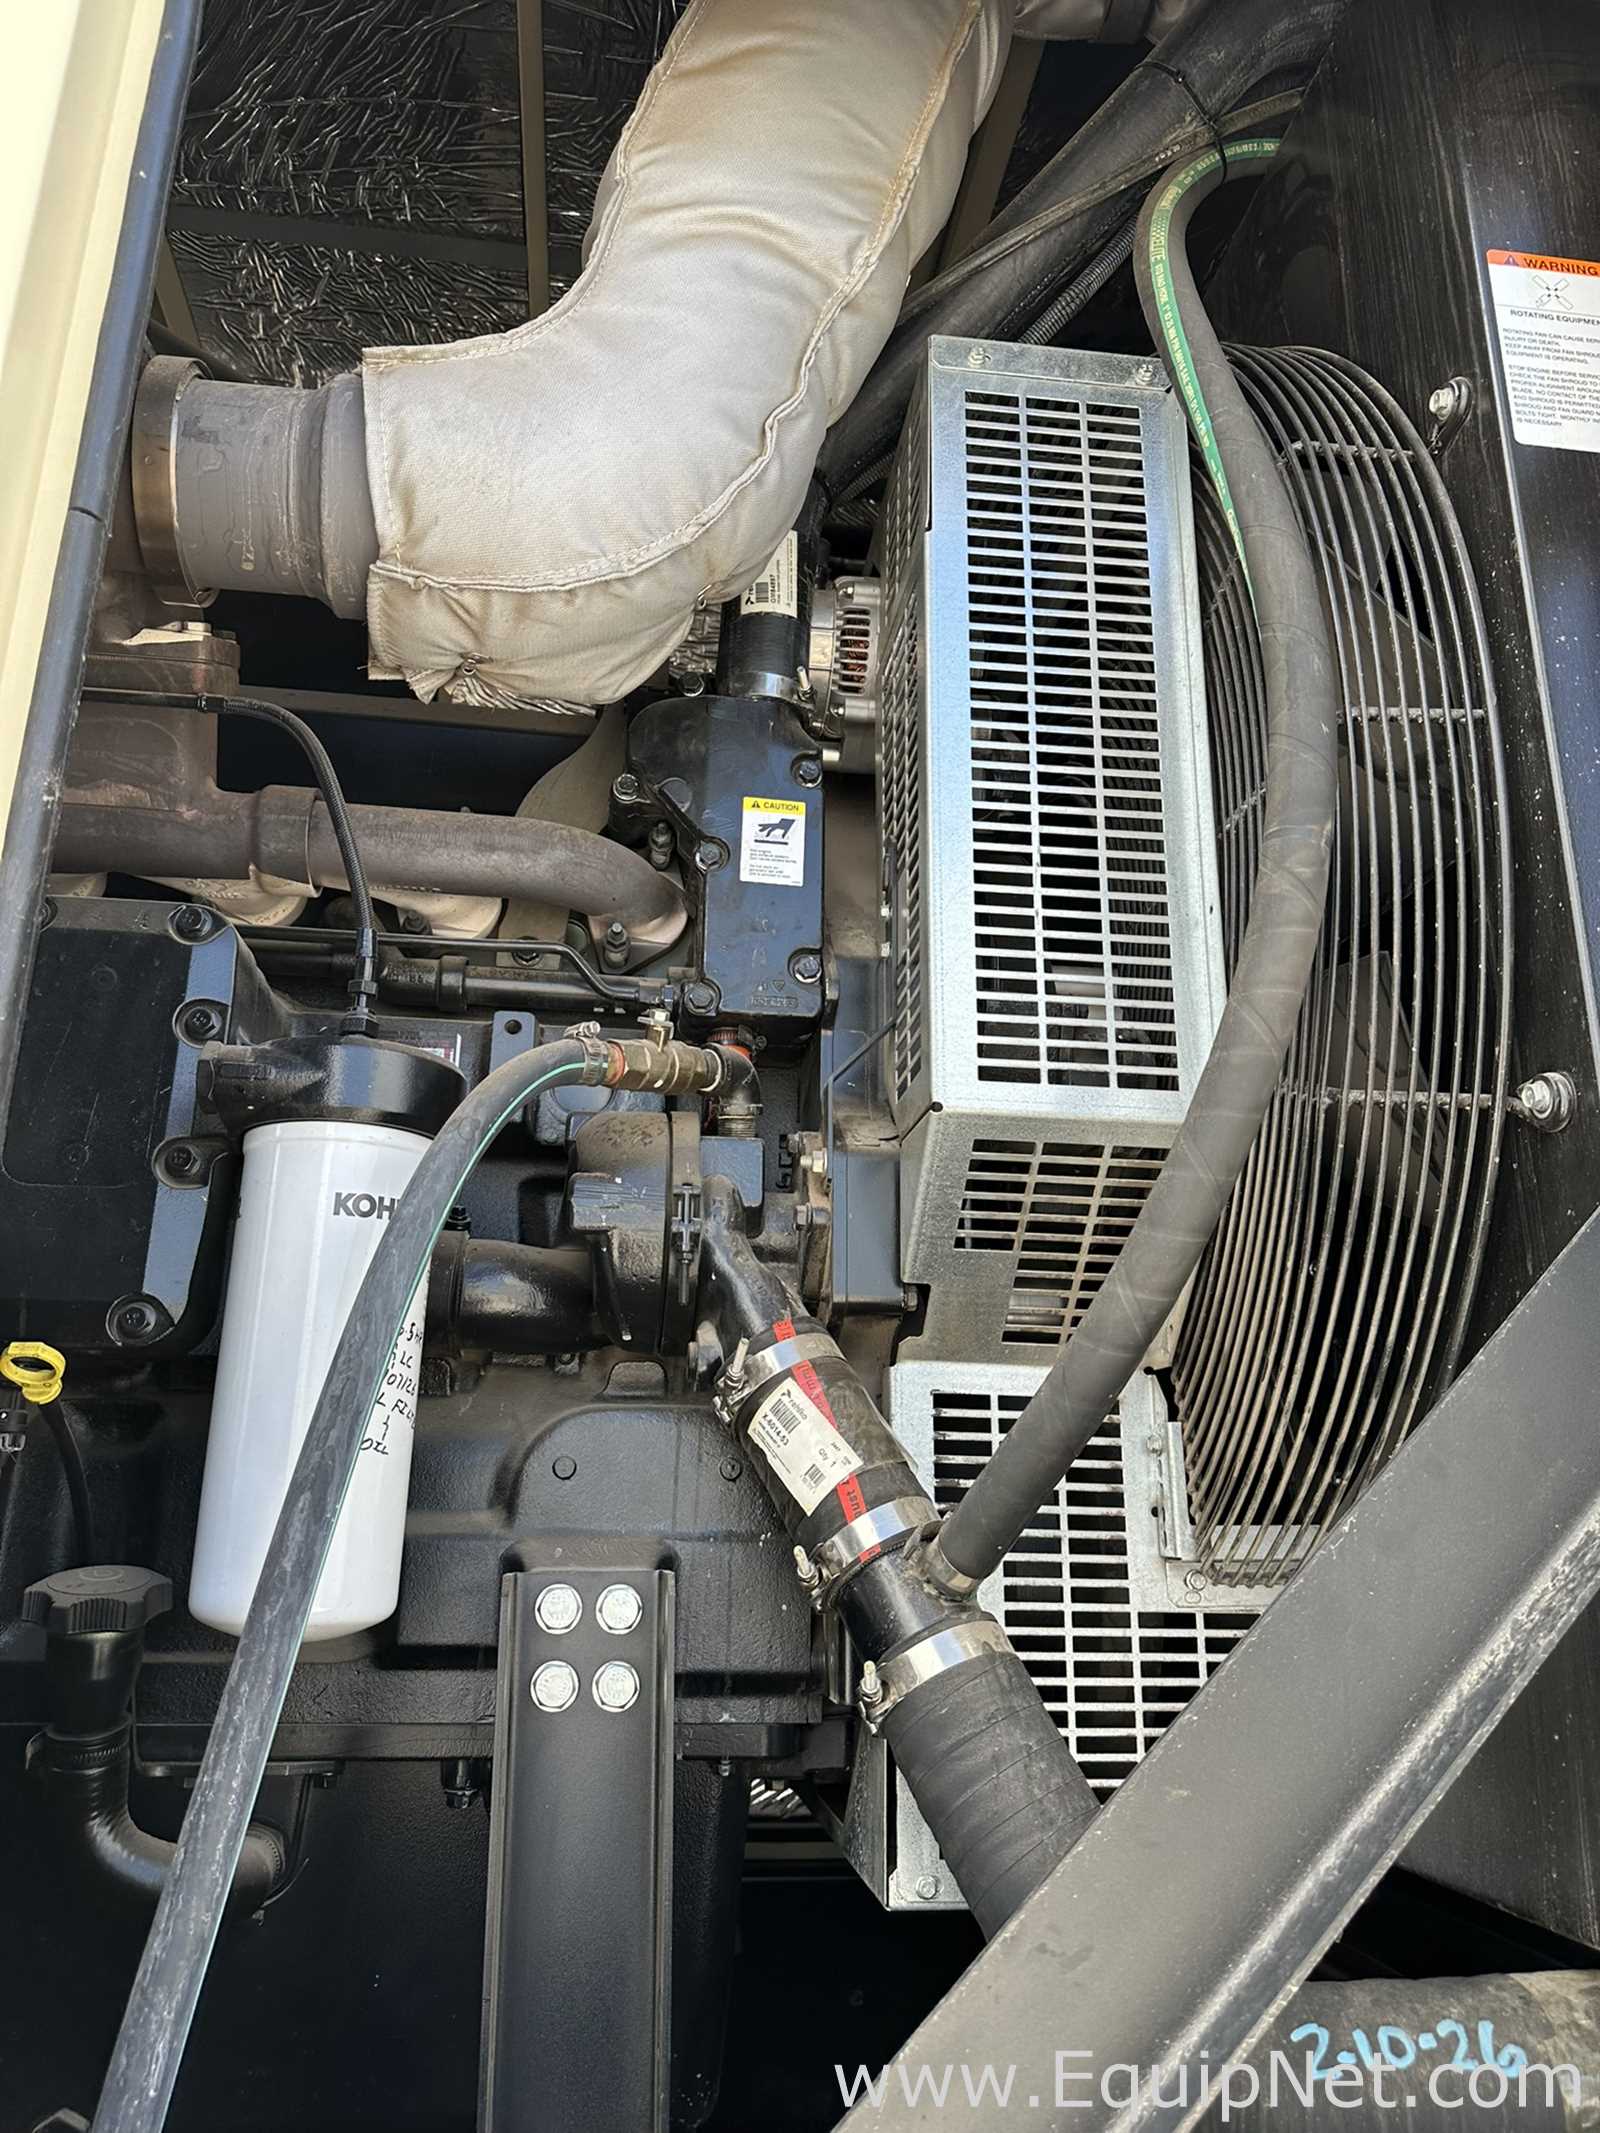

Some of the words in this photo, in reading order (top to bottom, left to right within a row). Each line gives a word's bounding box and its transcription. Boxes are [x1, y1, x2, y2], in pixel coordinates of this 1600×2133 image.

[1151, 239, 1166, 262] ELITE
[1523, 257, 1598, 277] WARNING
[1510, 309, 1555, 321] ROTATING
[1563, 335, 1584, 343] CAUSE
[1561, 378, 1588, 386] SHROUD
[1547, 391, 1577, 399] CONTACT
[763, 801, 799, 812] CAUTION
[332, 1191, 400, 1221] KOH
